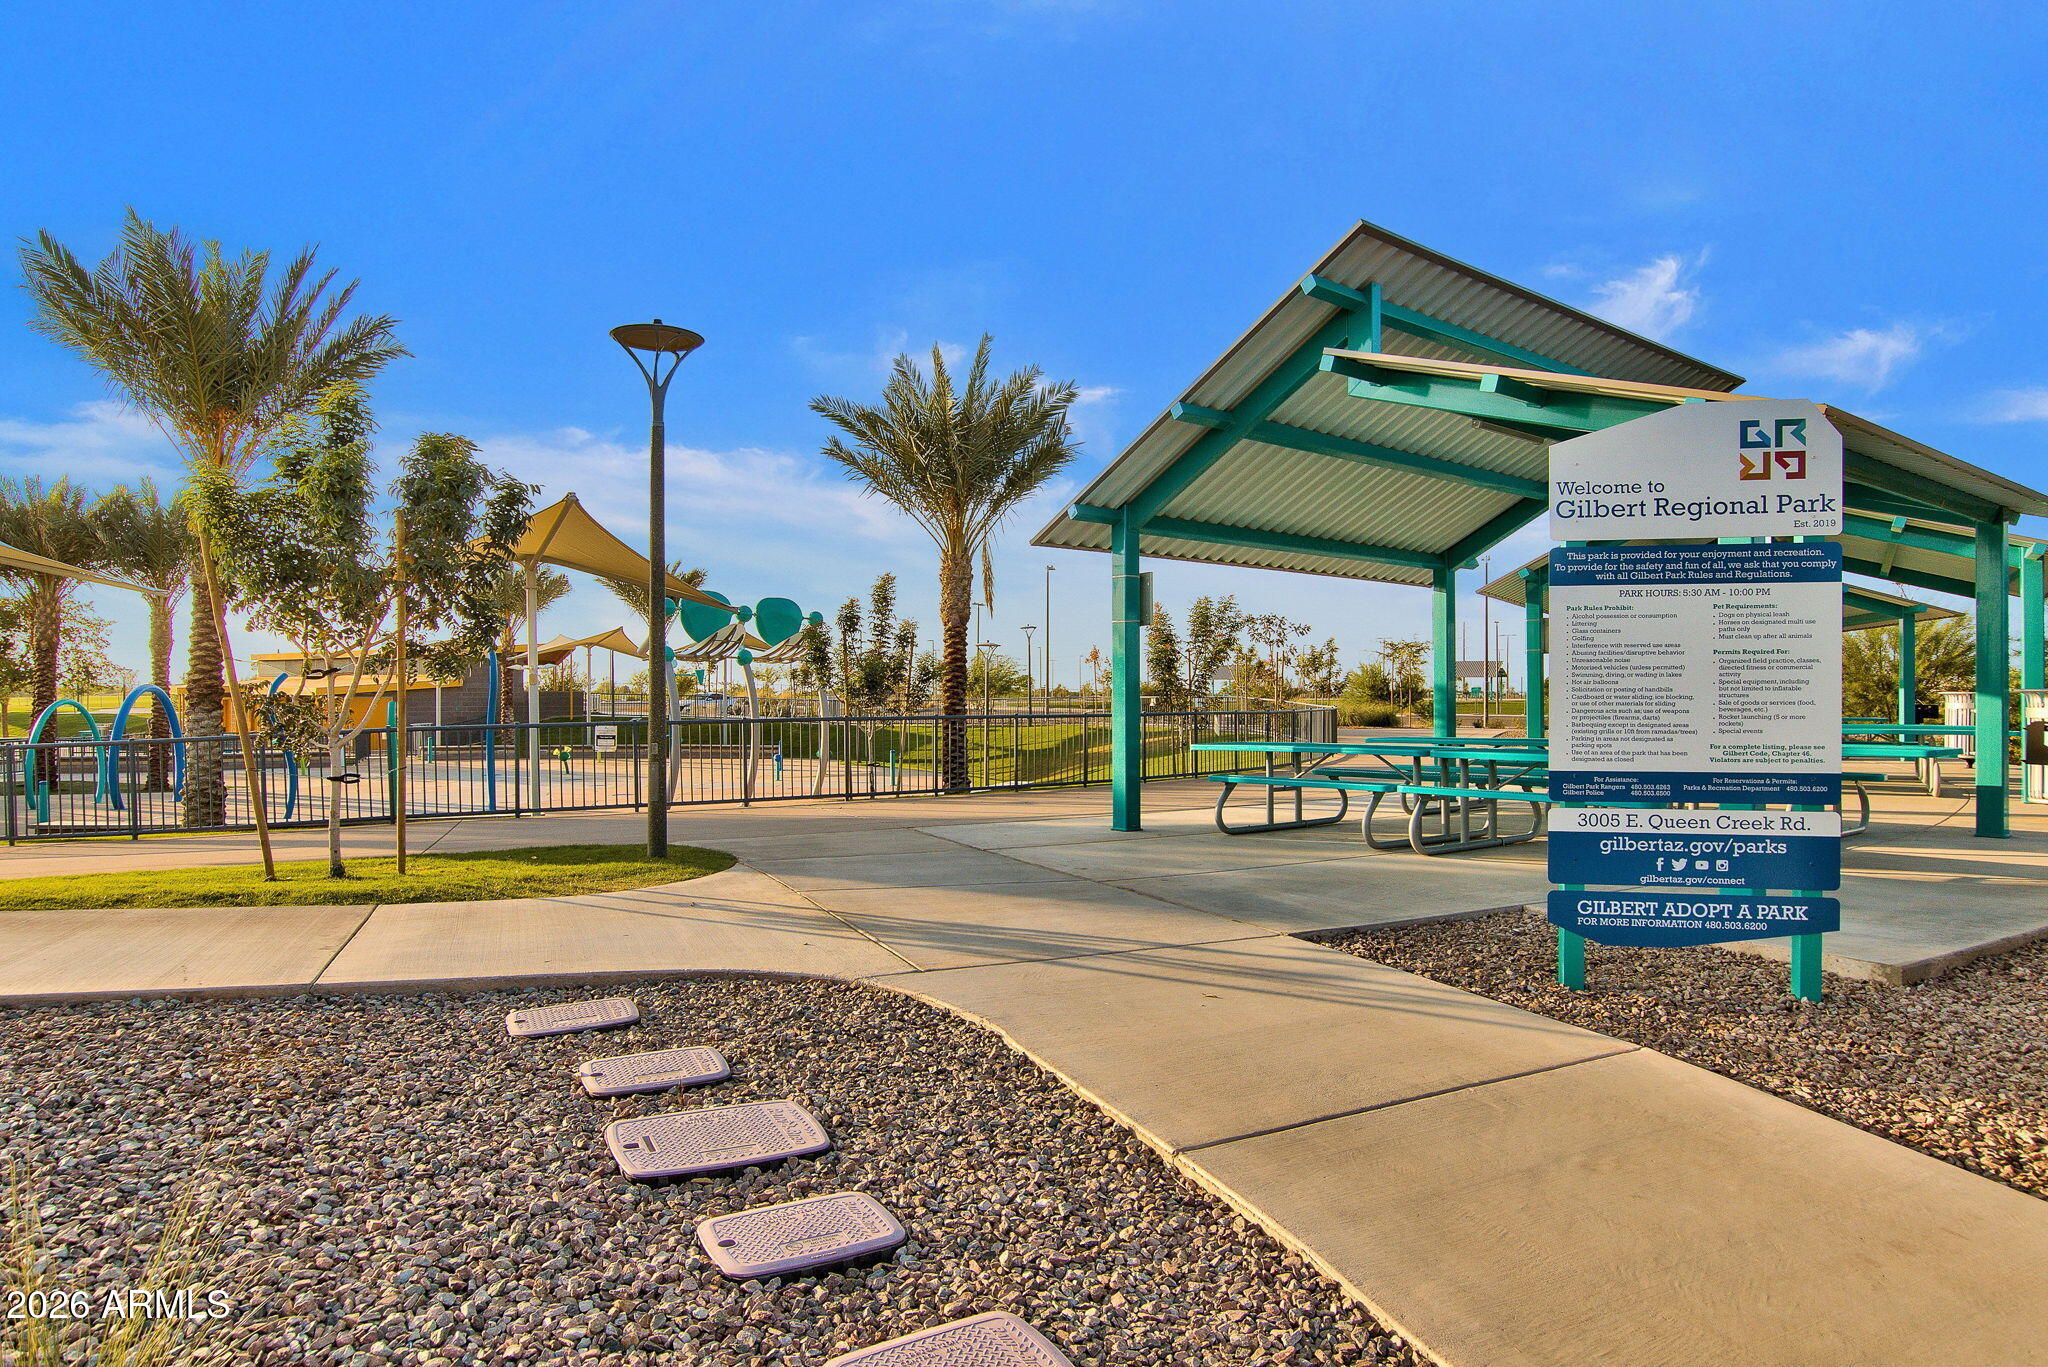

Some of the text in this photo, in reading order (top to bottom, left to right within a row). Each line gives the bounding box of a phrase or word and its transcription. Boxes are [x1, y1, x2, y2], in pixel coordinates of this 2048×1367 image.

[1555, 480, 1665, 496] Welcome to
[1555, 494, 1836, 521] Gilbert Regional Park
[1793, 519, 1836, 528] Est. 2019
[1567, 552, 1586, 560] This
[1587, 552, 1609, 561] park
[1620, 551, 1662, 561] provided
[1678, 552, 1700, 560] your
[1702, 550, 1752, 560] enjoyment
[1753, 549, 1771, 557] and
[1773, 549, 1824, 557] recreation.
[1555, 563, 1566, 571] To
[1567, 563, 1603, 573] provide
[1619, 562, 1634, 570] the
[1635, 562, 1663, 572] safety
[1701, 561, 1711, 569] of
[1712, 561, 1727, 570] all,
[1781, 562, 1799, 570] you
[1800, 560, 1837, 570] comply
[1595, 572, 1615, 580] with
[1617, 572, 1628, 580] all
[1665, 571, 1686, 579] Park
[1687, 571, 1713, 579] Rules
[1734, 570, 1793, 580] Regulations.
[1619, 589, 1644, 597] PARK
[1645, 589, 1681, 597] HOURS:
[1704, 588, 1721, 596] AM
[1729, 588, 1753, 596] 10:00
[1755, 588, 1771, 596] PM
[1742, 785, 1780, 793] Department
[1577, 813, 1811, 831] 3005 E. Queen Creek Rd.
[1599, 836, 1787, 857] gilbertaz.gov/parks
[1640, 874, 1745, 886] gilbertaz.gov/connect
[1577, 900, 1809, 921] GILBERT ADOPT A PARK
[1577, 917, 1767, 931] FOR MORE INFORMATION 480.503.6200
